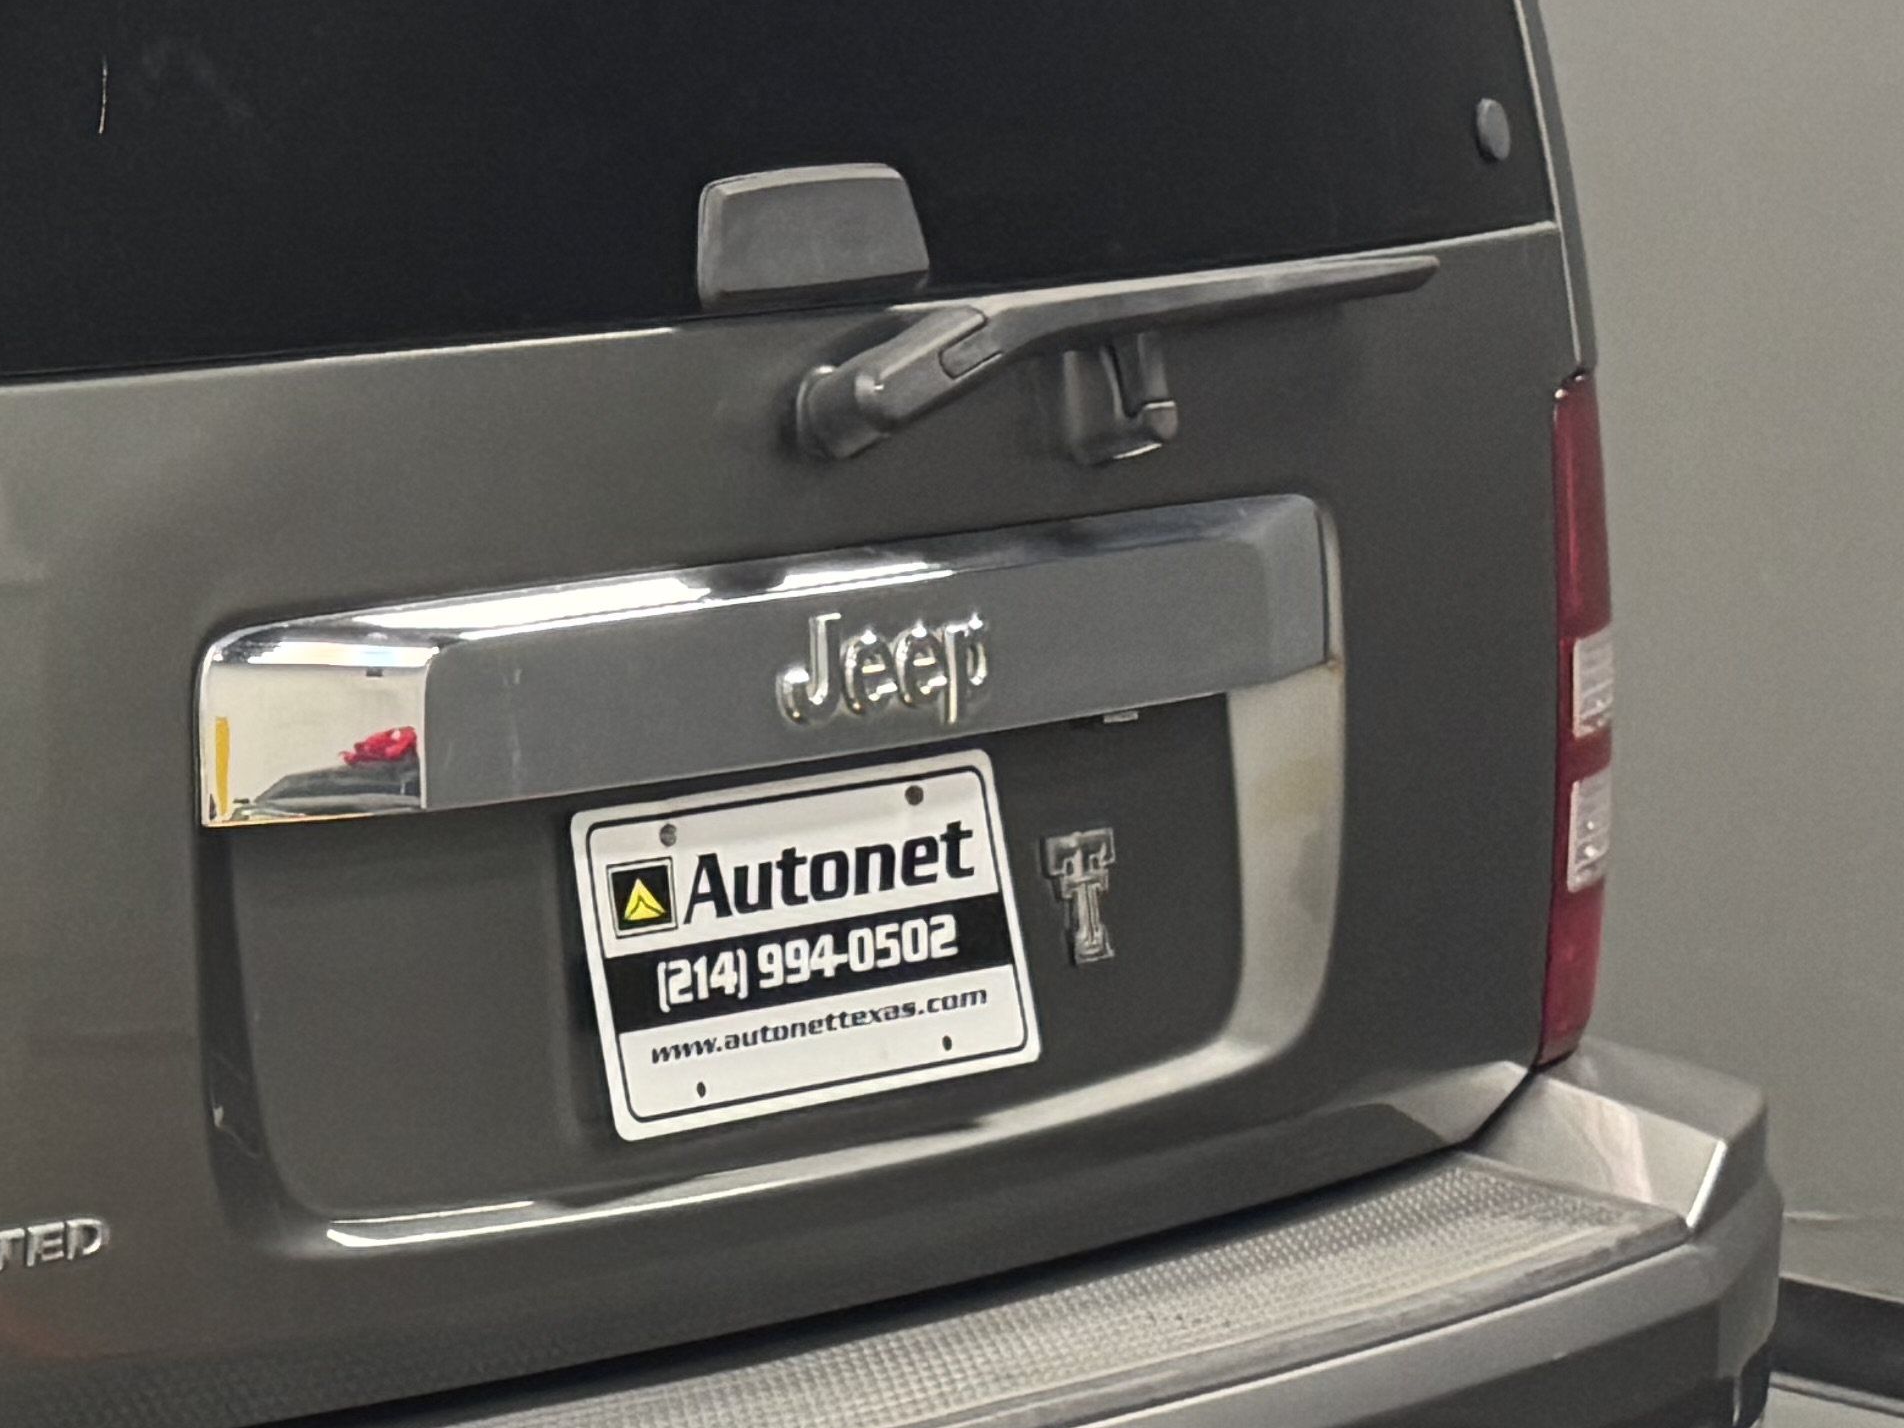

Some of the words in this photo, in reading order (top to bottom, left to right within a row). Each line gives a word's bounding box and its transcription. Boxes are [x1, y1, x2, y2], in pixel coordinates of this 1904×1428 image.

[776, 612, 989, 724] Jeep
[683, 820, 975, 925] Autonet
[658, 948, 749, 1012] (214)
[757, 914, 959, 989] 994-0502
[650, 988, 988, 1064] www.autonettexas.com
